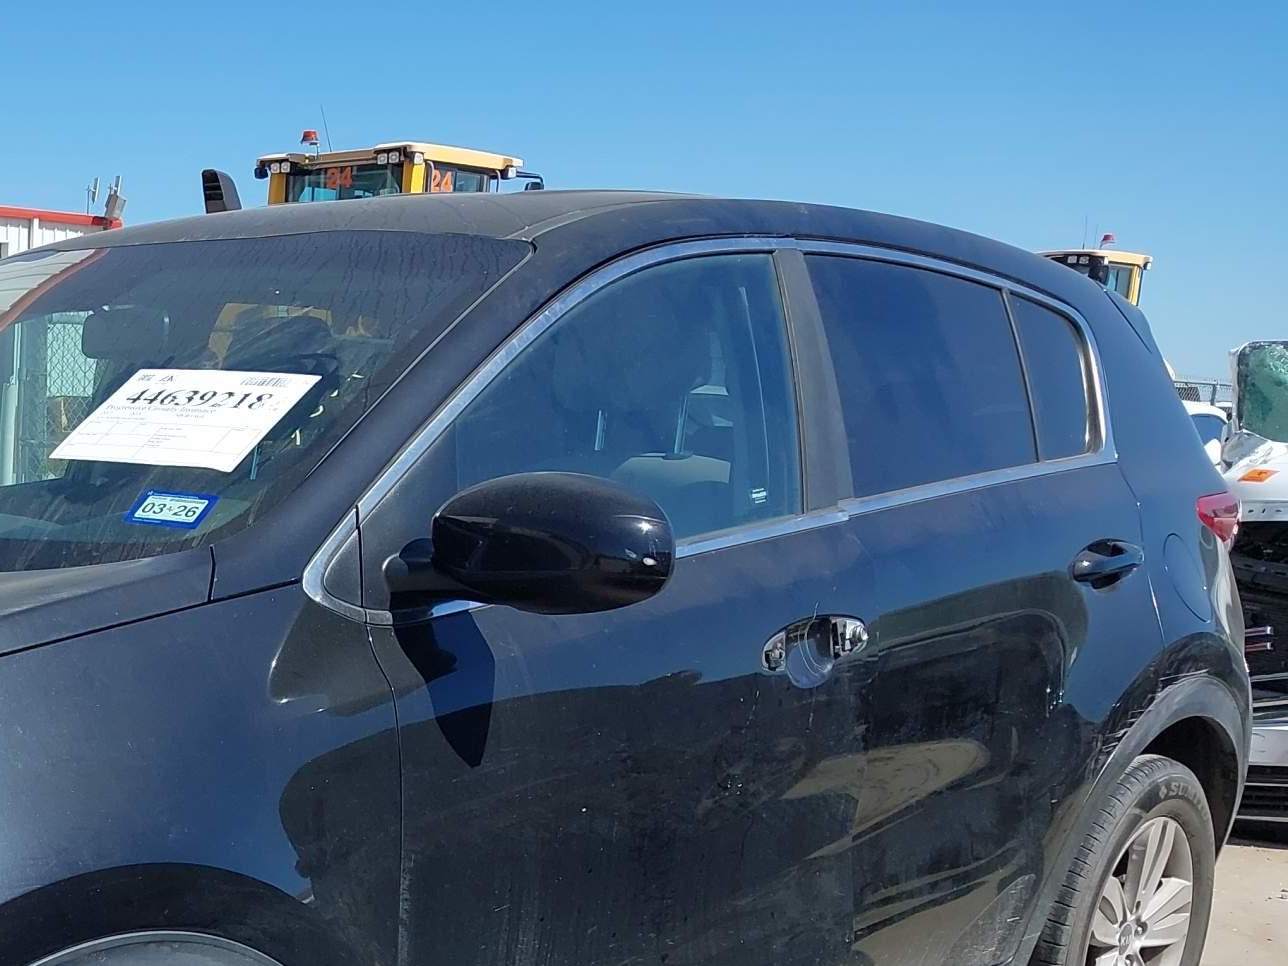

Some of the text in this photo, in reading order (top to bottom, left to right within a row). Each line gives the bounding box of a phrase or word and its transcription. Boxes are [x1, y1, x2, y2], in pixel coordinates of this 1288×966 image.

[326, 167, 352, 188] 24
[430, 170, 452, 192] 24
[126, 387, 274, 410] 44639218
